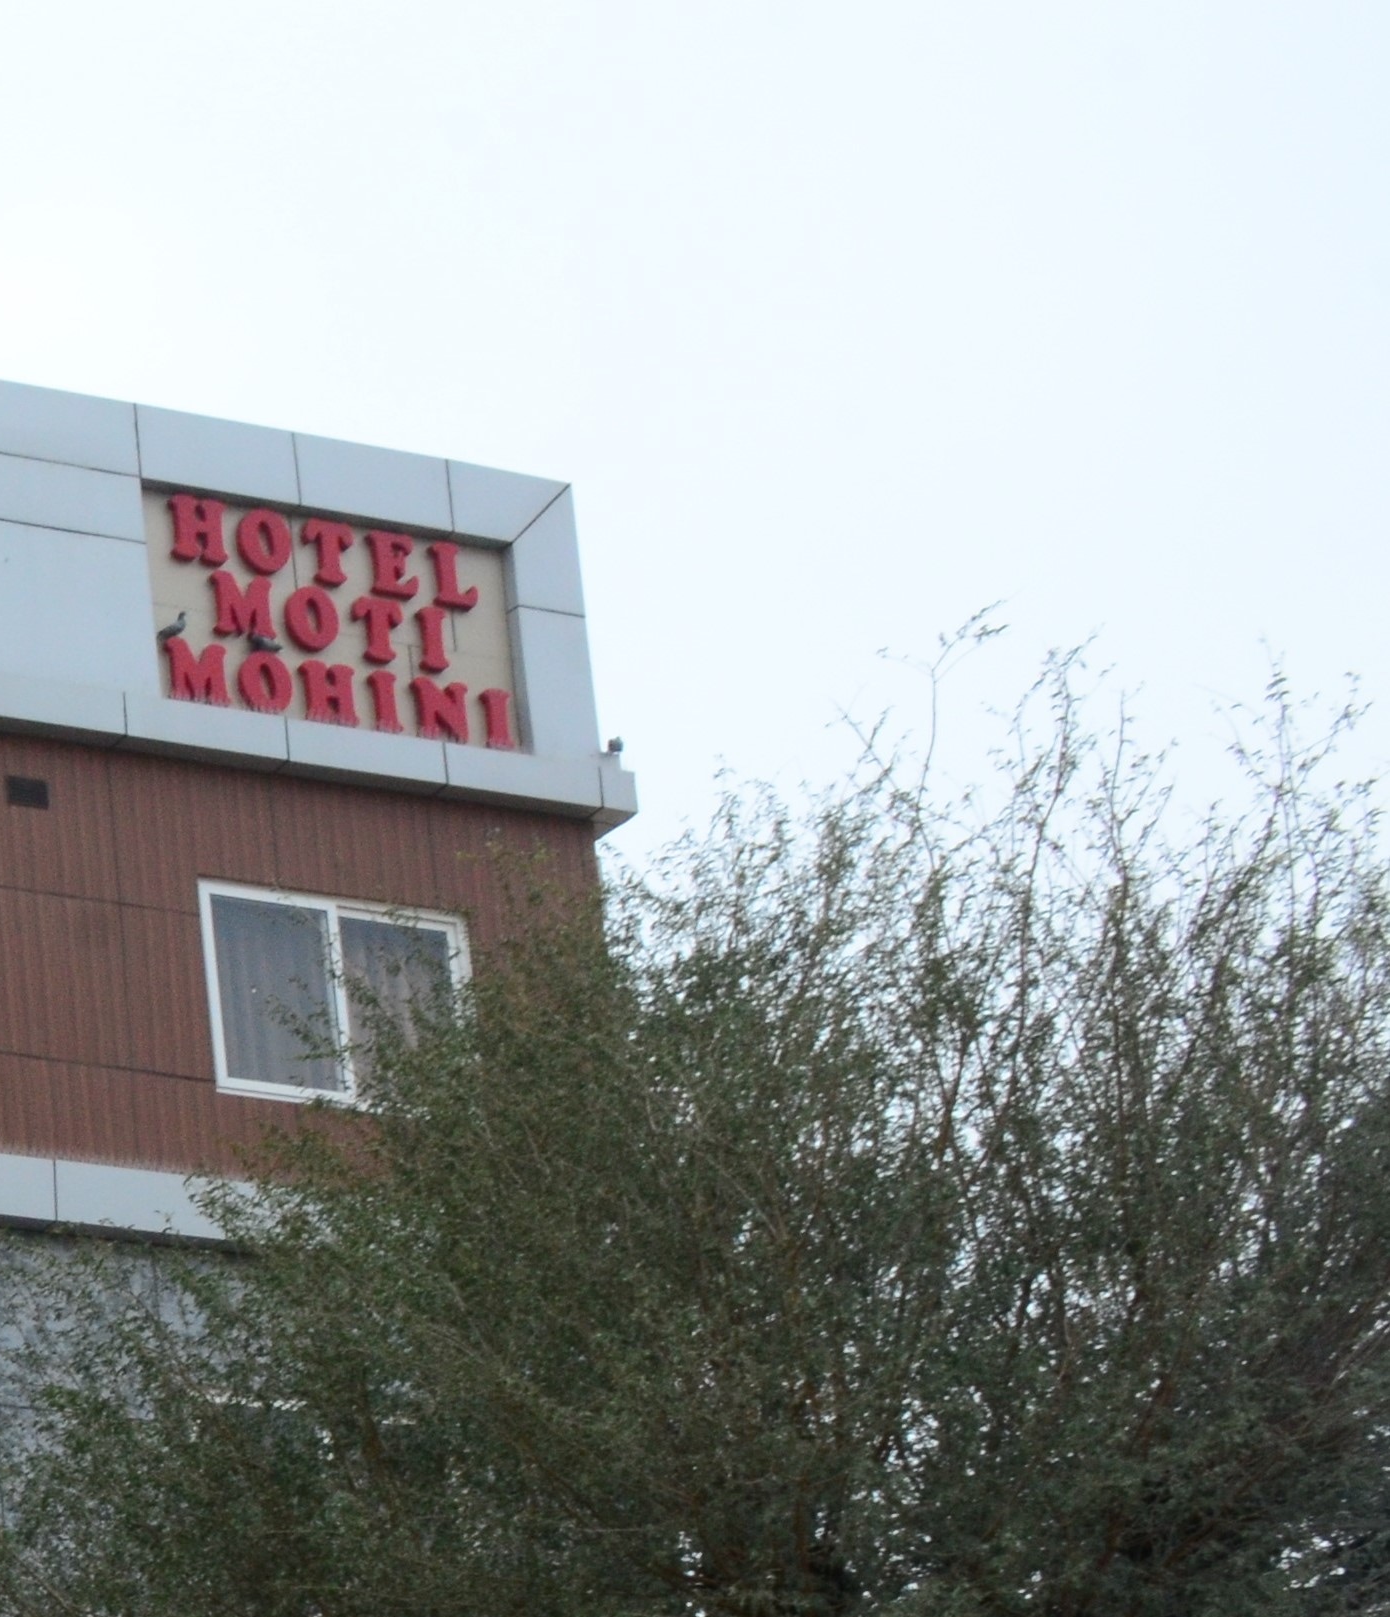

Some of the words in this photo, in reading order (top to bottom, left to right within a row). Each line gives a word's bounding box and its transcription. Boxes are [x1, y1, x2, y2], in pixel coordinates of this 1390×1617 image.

[167, 493, 479, 612] HOTEL
[209, 569, 450, 674] MOTI
[164, 635, 516, 750] MOHINI
